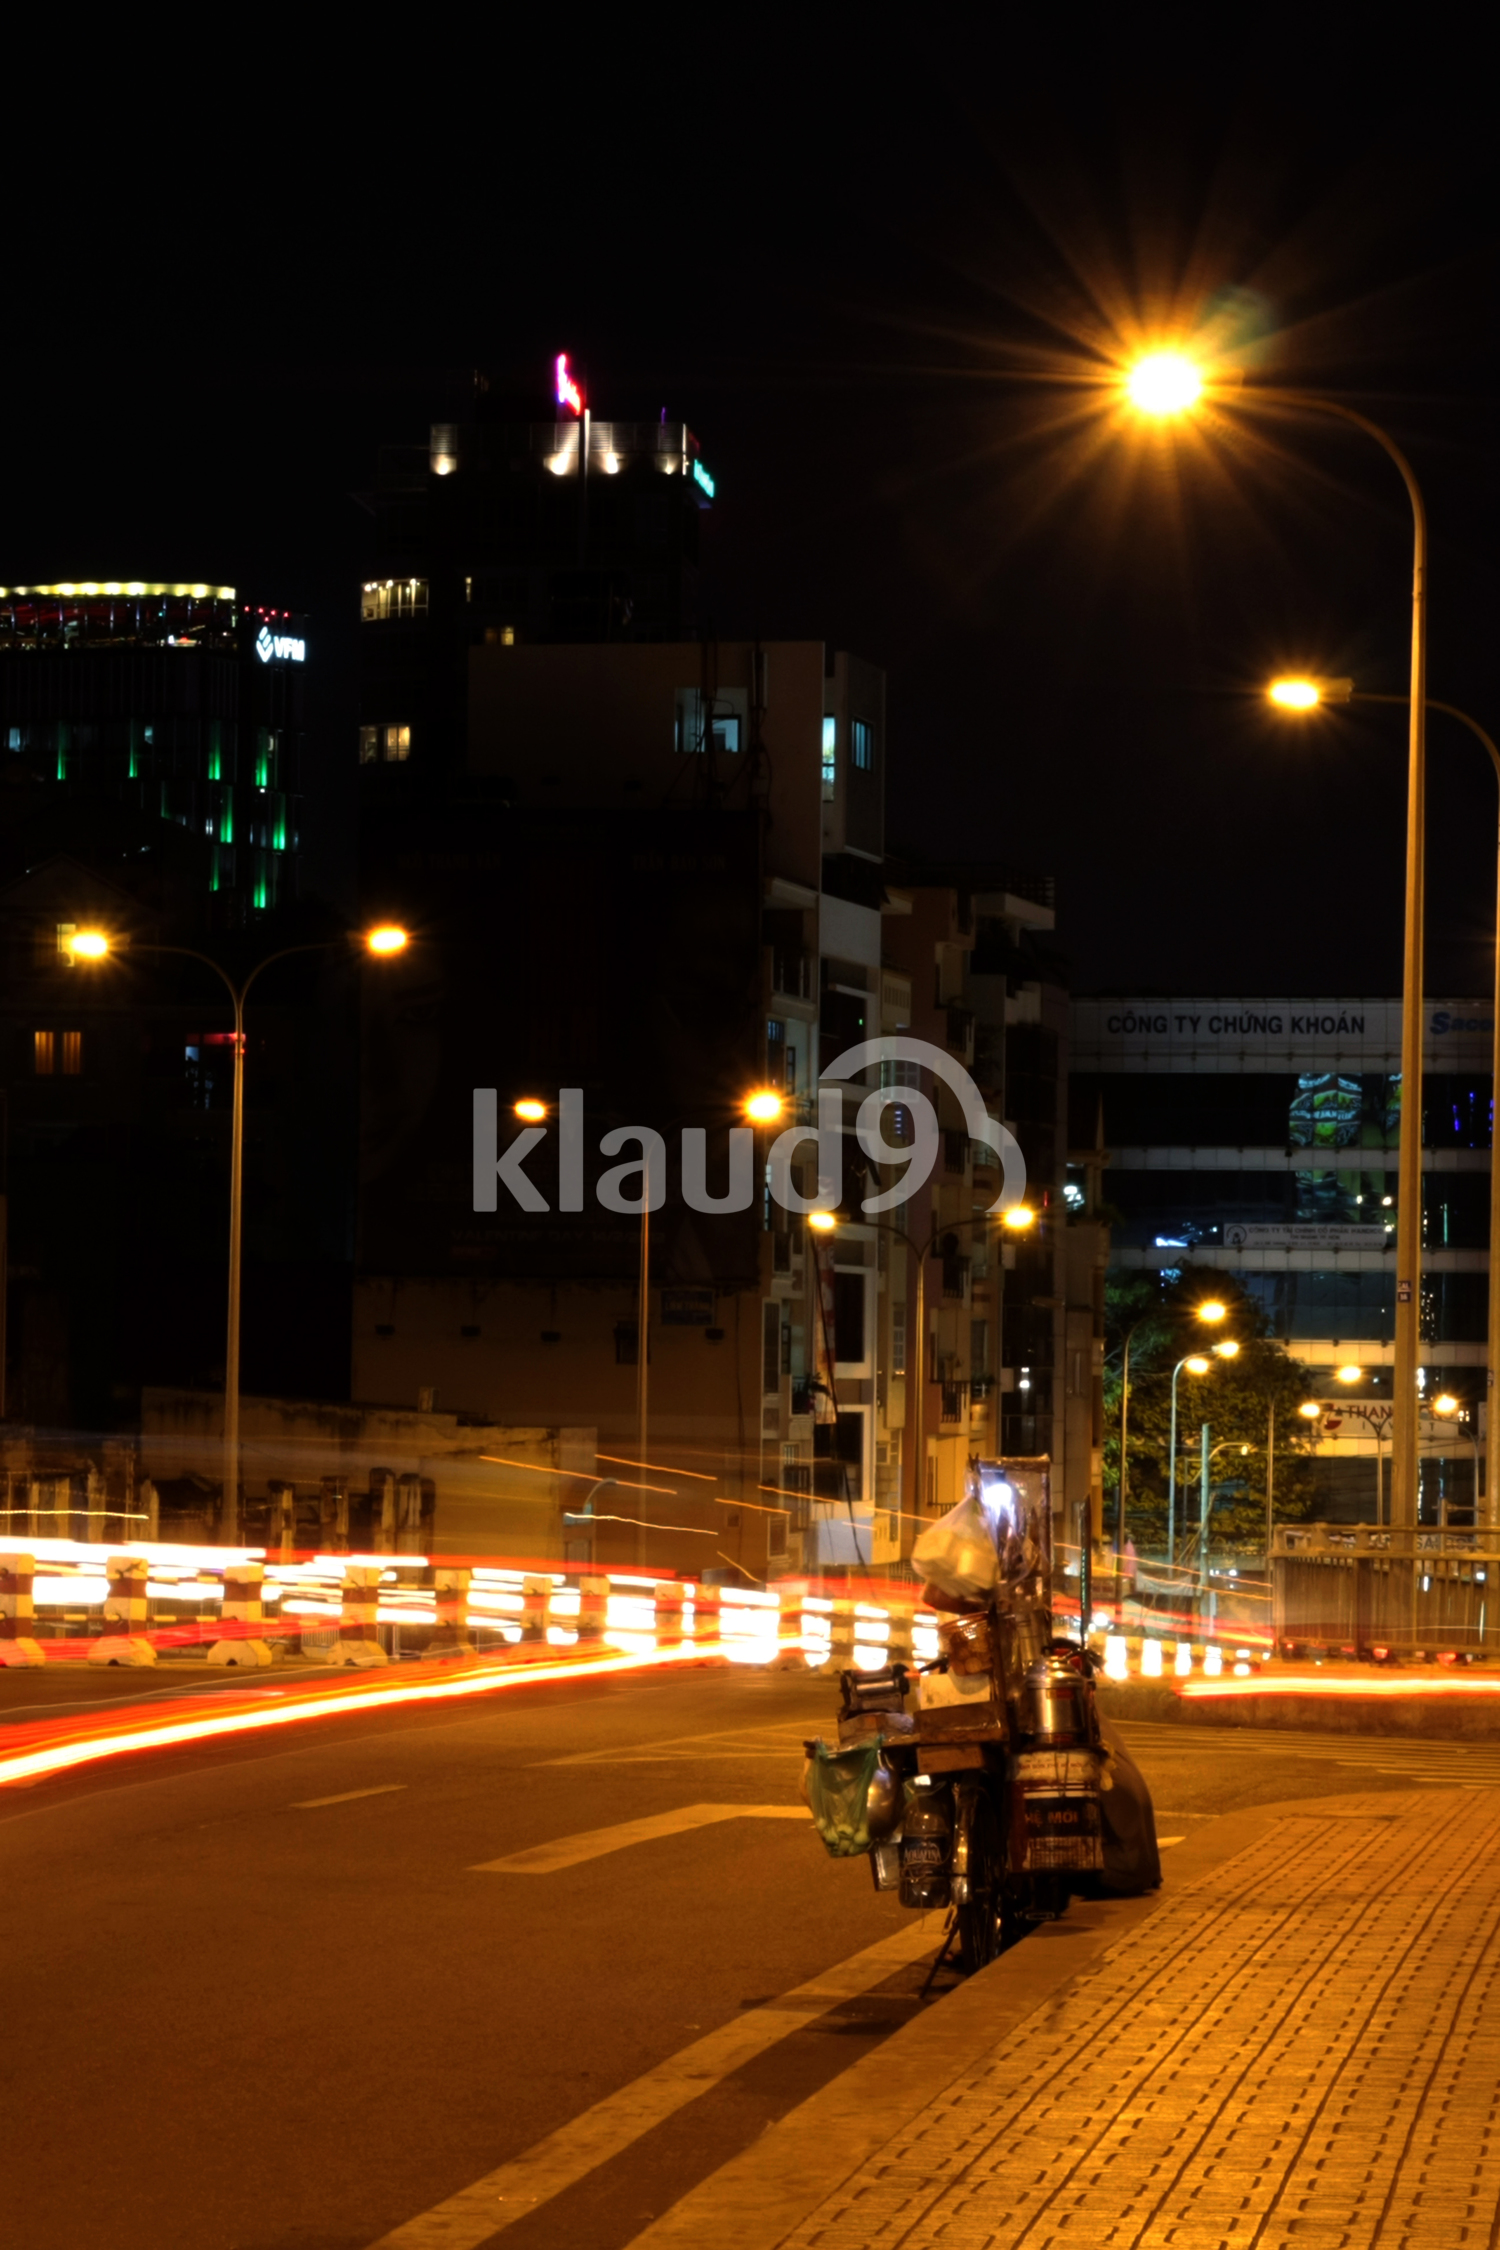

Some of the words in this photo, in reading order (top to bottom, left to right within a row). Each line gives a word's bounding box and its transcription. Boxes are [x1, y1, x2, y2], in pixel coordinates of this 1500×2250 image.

[274, 636, 305, 661] VFM
[1107, 1011, 1168, 1034] CÔNG
[1174, 1016, 1201, 1033] TY
[1208, 1010, 1283, 1034] CHỨNG
[1290, 1010, 1365, 1034] KHOÁN
